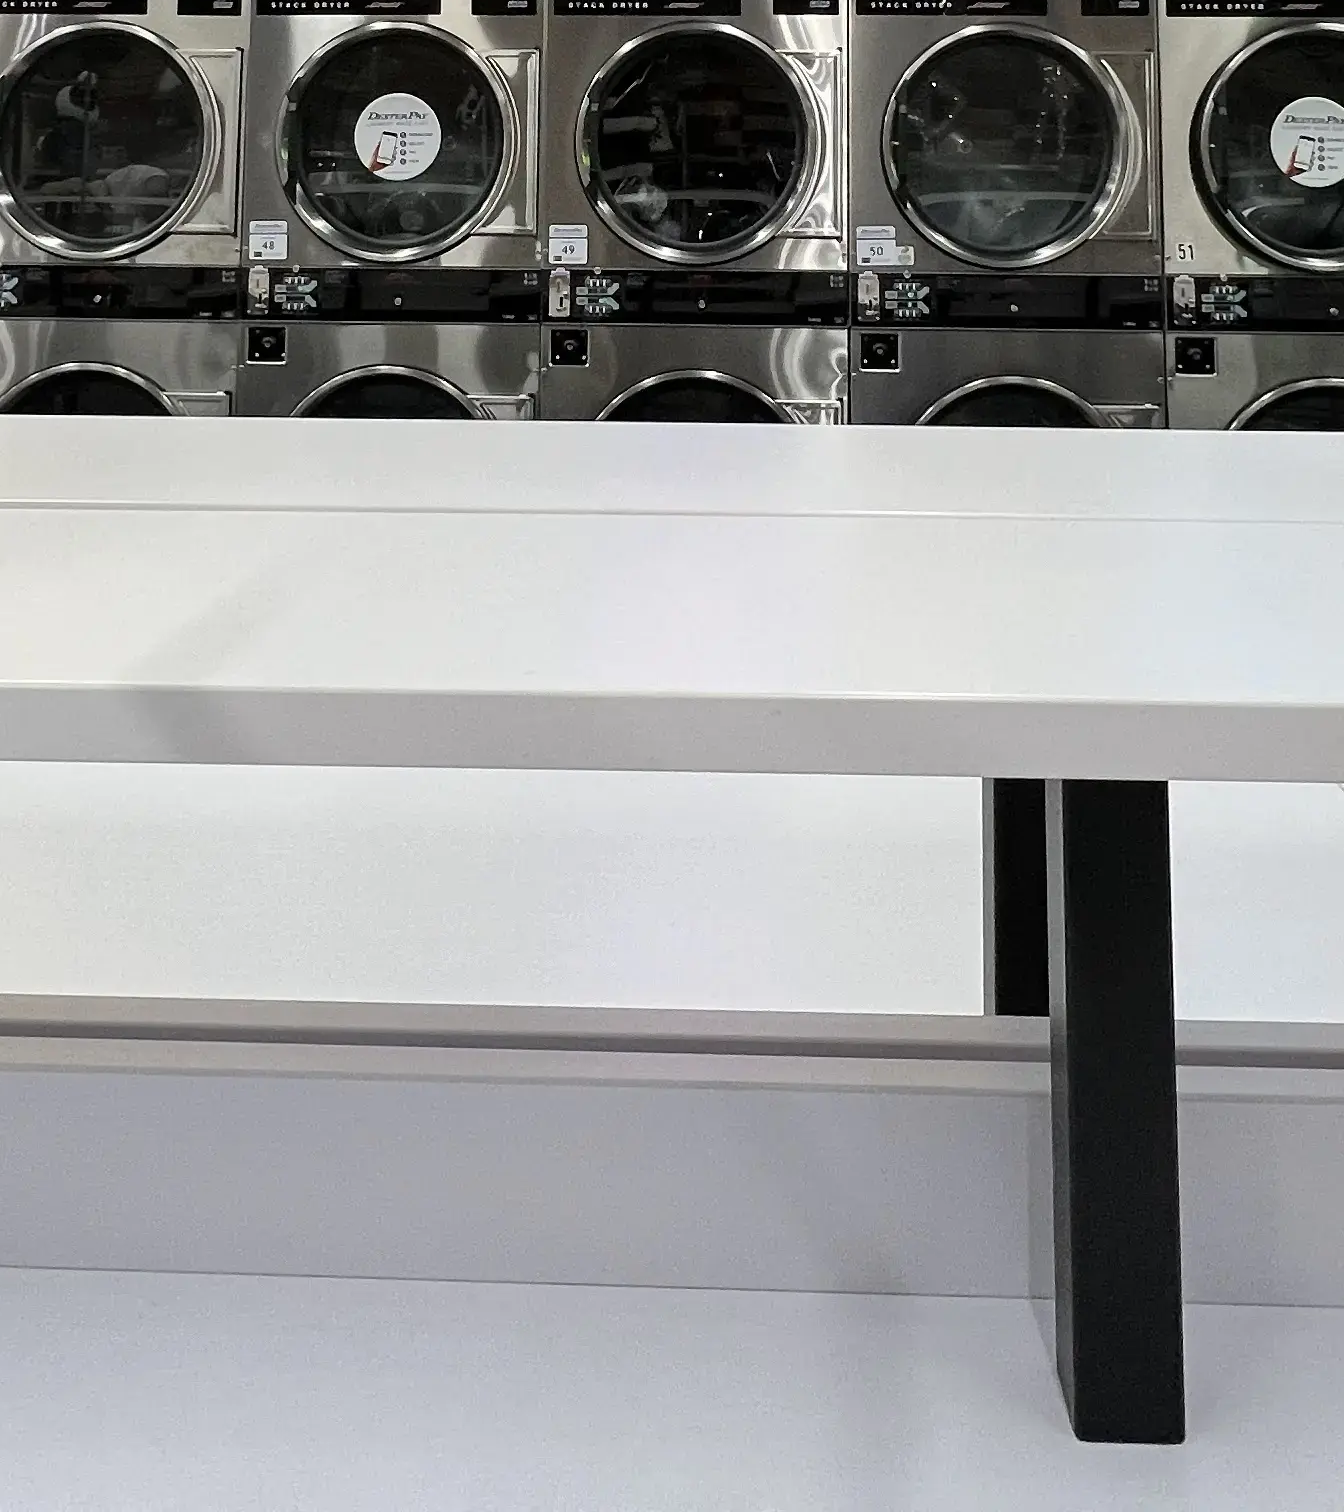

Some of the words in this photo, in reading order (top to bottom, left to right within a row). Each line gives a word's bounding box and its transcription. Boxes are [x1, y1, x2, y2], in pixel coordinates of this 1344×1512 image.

[261, 240, 275, 251] 48
[561, 244, 575, 255] 49
[869, 246, 884, 257] 50
[1177, 243, 1195, 261] 51
